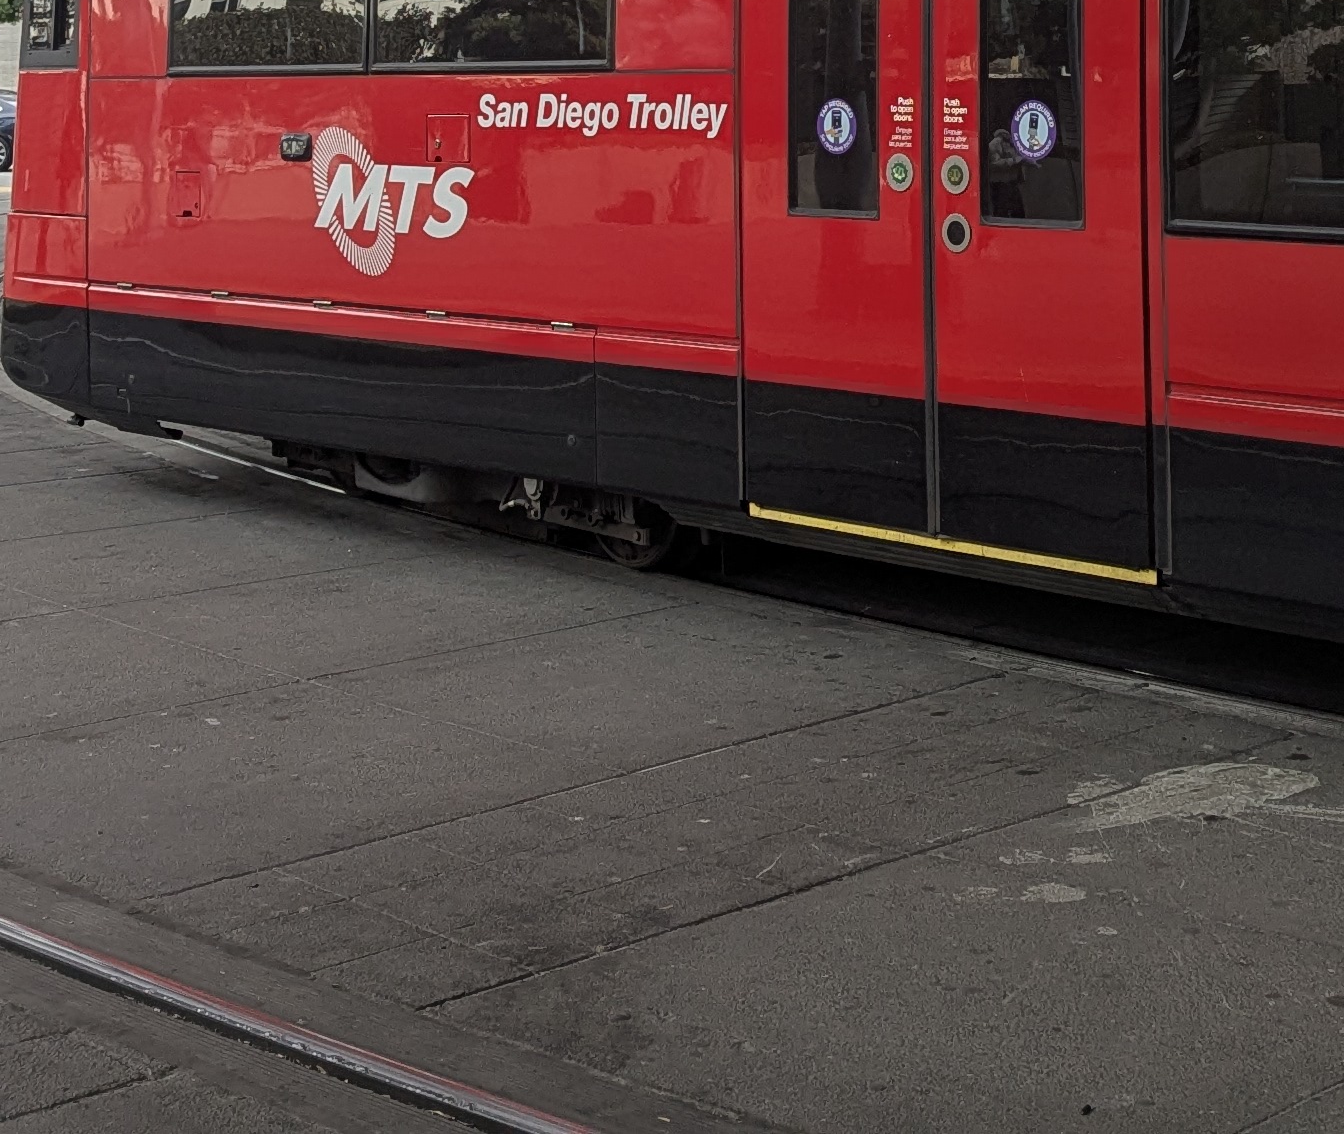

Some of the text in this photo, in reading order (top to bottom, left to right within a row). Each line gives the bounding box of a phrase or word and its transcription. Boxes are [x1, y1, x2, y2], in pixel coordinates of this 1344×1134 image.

[897, 97, 913, 105] Push
[943, 97, 960, 106] Push
[890, 105, 897, 113] to
[943, 106, 968, 116] to open
[1015, 104, 1029, 122] SCAN
[477, 93, 728, 139] San Diego Trolley
[893, 114, 913, 122] doors.
[943, 115, 964, 123] doors.
[314, 164, 474, 239] MTS
